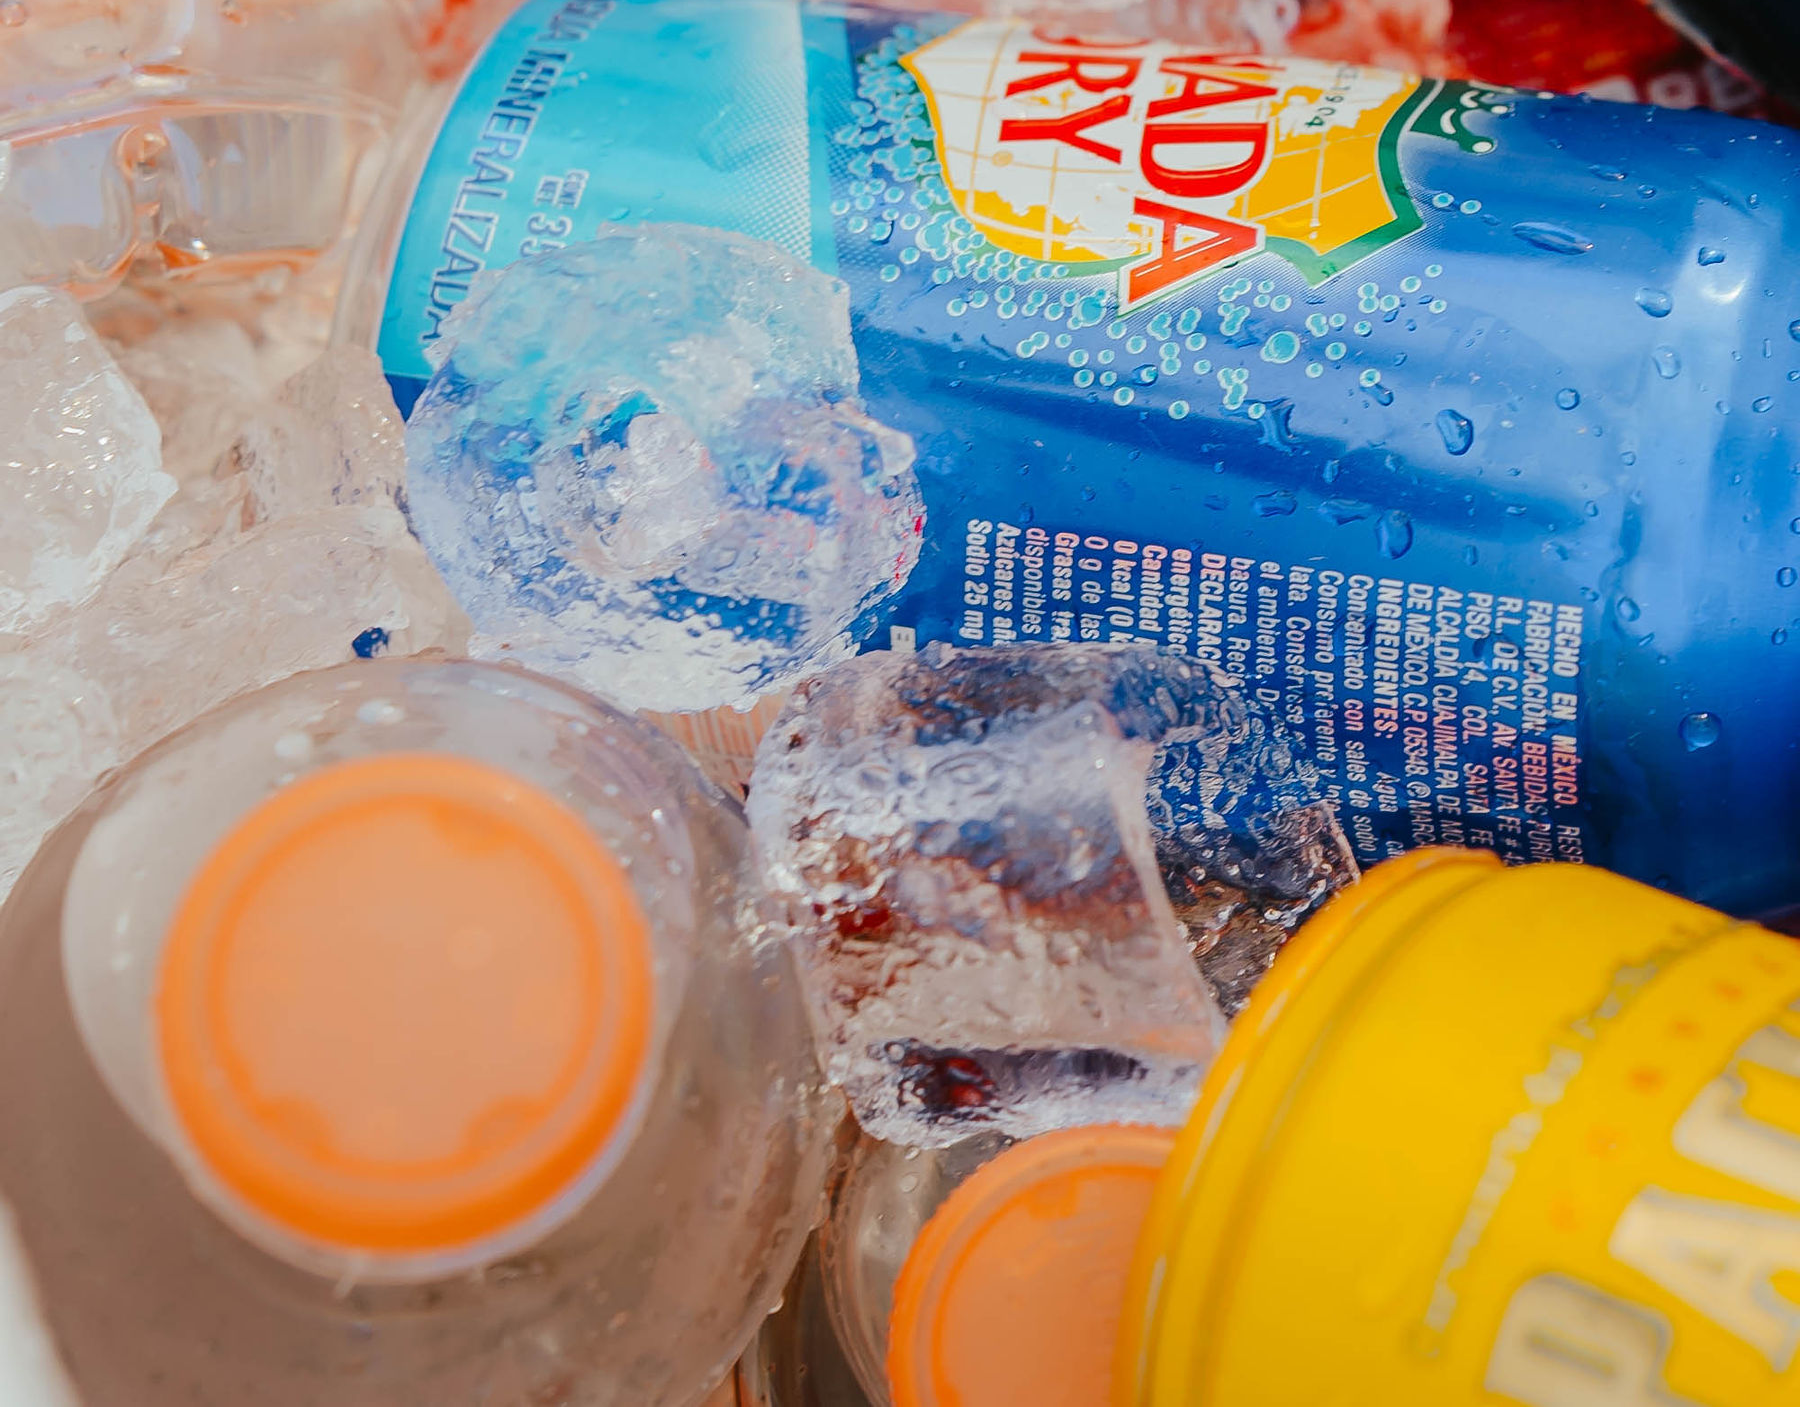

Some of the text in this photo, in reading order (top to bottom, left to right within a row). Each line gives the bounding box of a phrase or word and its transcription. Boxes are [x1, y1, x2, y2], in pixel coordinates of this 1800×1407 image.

[999, 30, 1150, 164] RY
[959, 518, 994, 640] Sodio 25 mg
[993, 522, 1022, 612] Azúcares
[1018, 527, 1050, 635] disponibles
[1052, 532, 1079, 601] Grasas
[1079, 558, 1102, 571] g
[1110, 559, 1136, 601] kcal
[1138, 545, 1168, 631] Cantidad
[1260, 561, 1284, 579] el
[1287, 565, 1315, 607] lata.
[1080, 581, 1105, 604] de
[1107, 606, 1135, 627] (0
[1227, 557, 1255, 629] basura.
[1316, 570, 1344, 663] Consumo
[1407, 582, 1430, 611] DE
[1466, 591, 1493, 639] PISO
[1494, 596, 1521, 634] R.L.
[1080, 613, 1102, 639] las
[1434, 586, 1465, 677] ALCALDÍA
[1553, 605, 1583, 677] HECHO
[1372, 578, 1404, 740] INGREDIENTES:
[1492, 642, 1519, 671] DE
[1522, 601, 1556, 737] FABRICACIÓN:
[1343, 574, 1377, 852] Concentrado con sales de sodio
[1462, 705, 1488, 745] COL.
[1552, 692, 1577, 720] EN
[1432, 684, 1459, 790] CUAJIMALPA
[1371, 771, 1401, 813] Agua
[1464, 762, 1490, 814] SANTA
[1492, 755, 1519, 811] SANTA
[1522, 741, 1548, 815] BEBIDAS
[1552, 735, 1582, 809] MÉXICO.
[1437, 794, 1461, 815] DE
[1497, 815, 1520, 834] FE
[1469, 829, 1494, 845] FE
